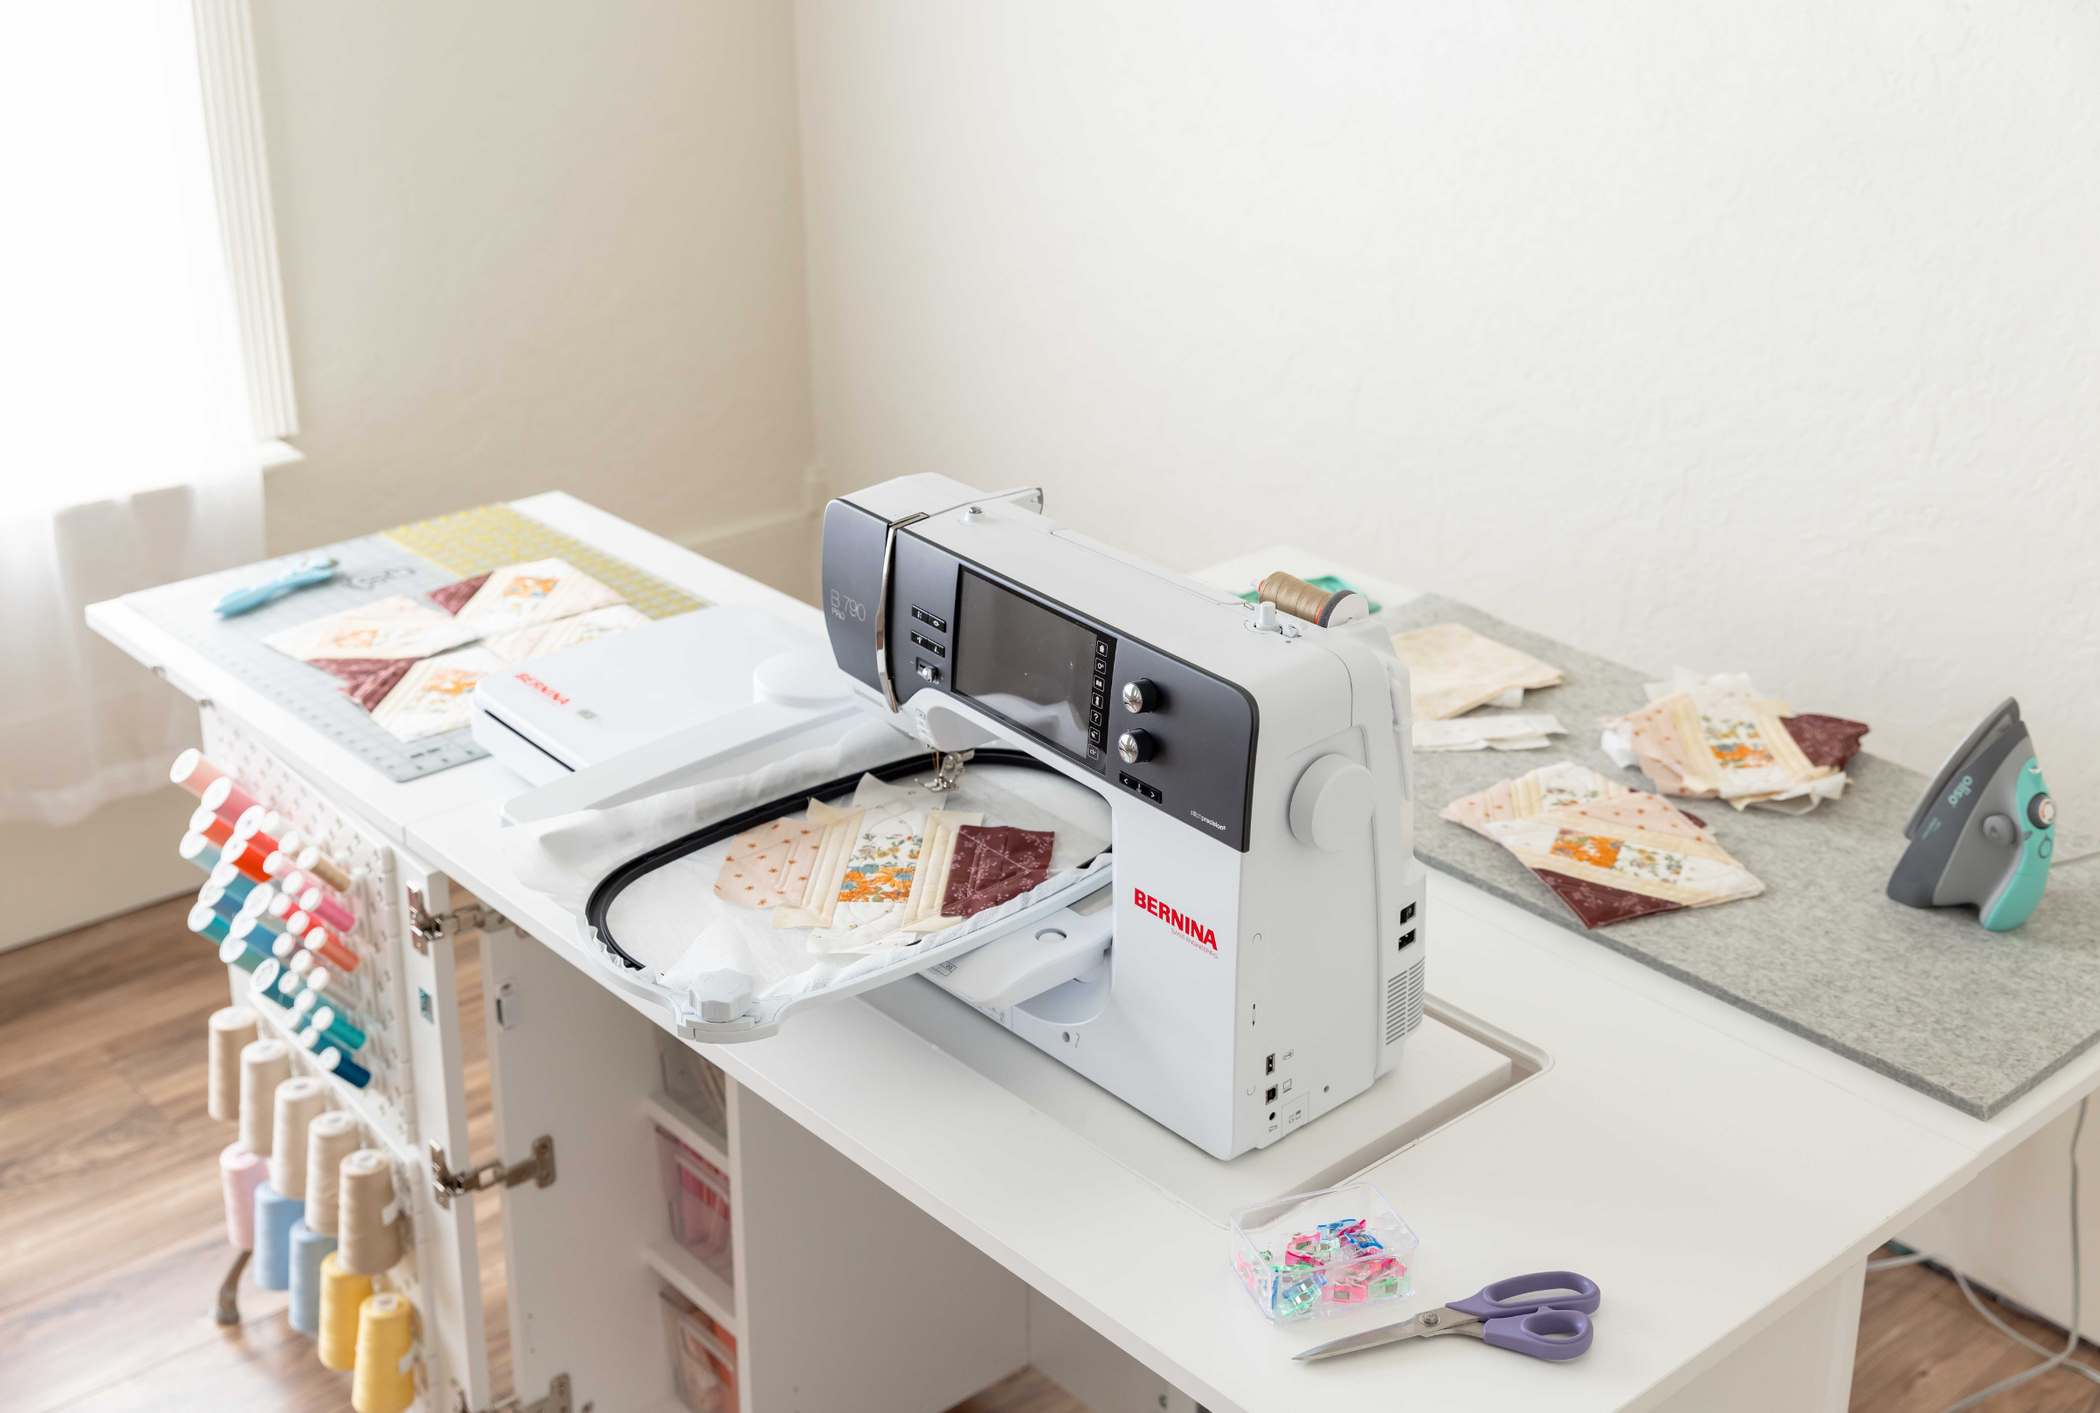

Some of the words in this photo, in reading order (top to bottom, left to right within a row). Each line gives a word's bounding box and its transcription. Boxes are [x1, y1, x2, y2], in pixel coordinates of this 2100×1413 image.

[830, 588, 841, 608] B
[843, 595, 866, 621] 790
[831, 606, 846, 621] PRO
[515, 672, 570, 705] BERNINA
[1947, 775, 1973, 806] oliso
[1134, 887, 1218, 951] BERNINA
